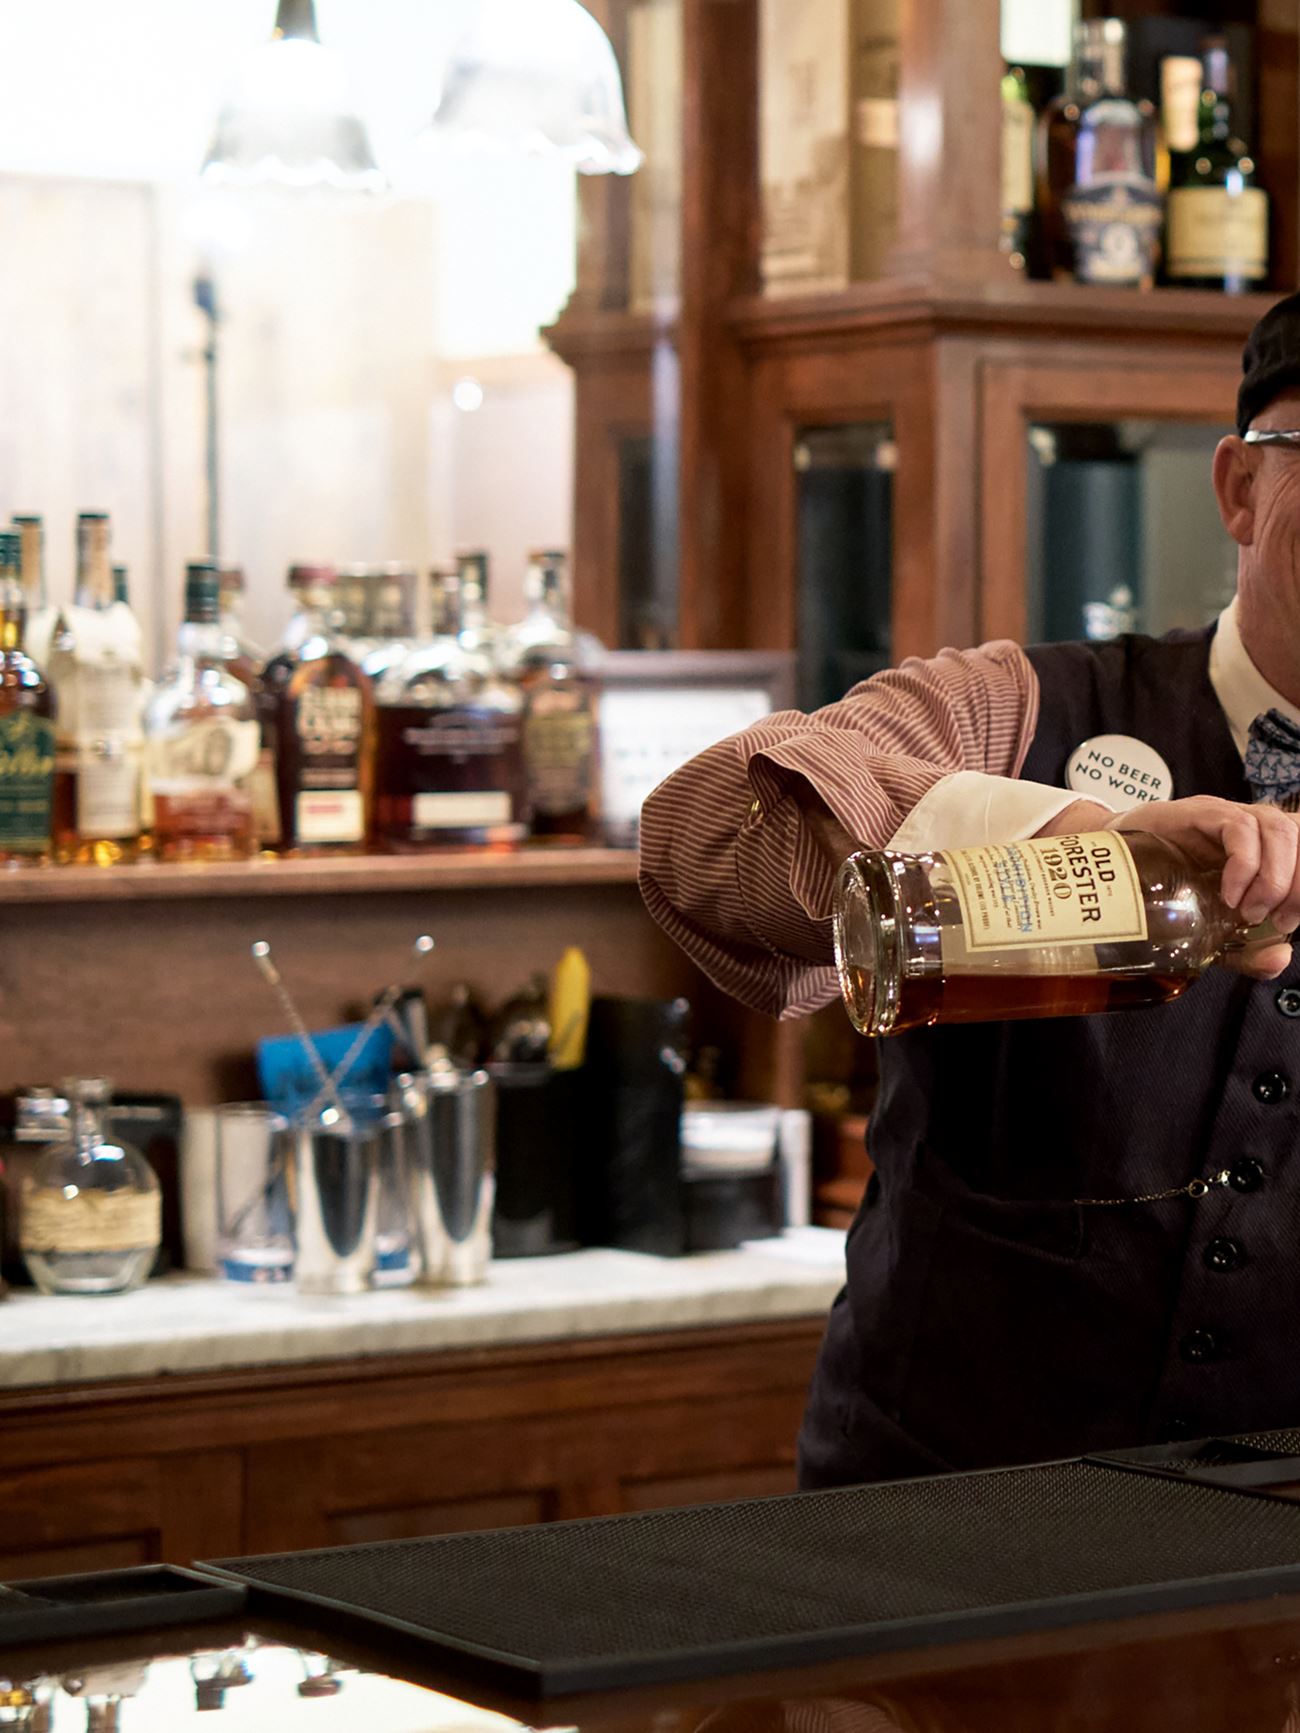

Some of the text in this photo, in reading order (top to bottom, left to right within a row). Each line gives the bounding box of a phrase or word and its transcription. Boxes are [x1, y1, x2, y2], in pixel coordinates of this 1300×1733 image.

[1075, 763, 1102, 780] NO
[1088, 750, 1161, 789] NO BEER
[1040, 848, 1071, 899] 1920
[1056, 835, 1101, 922] FORESTER
[1091, 847, 1115, 882] OLD
